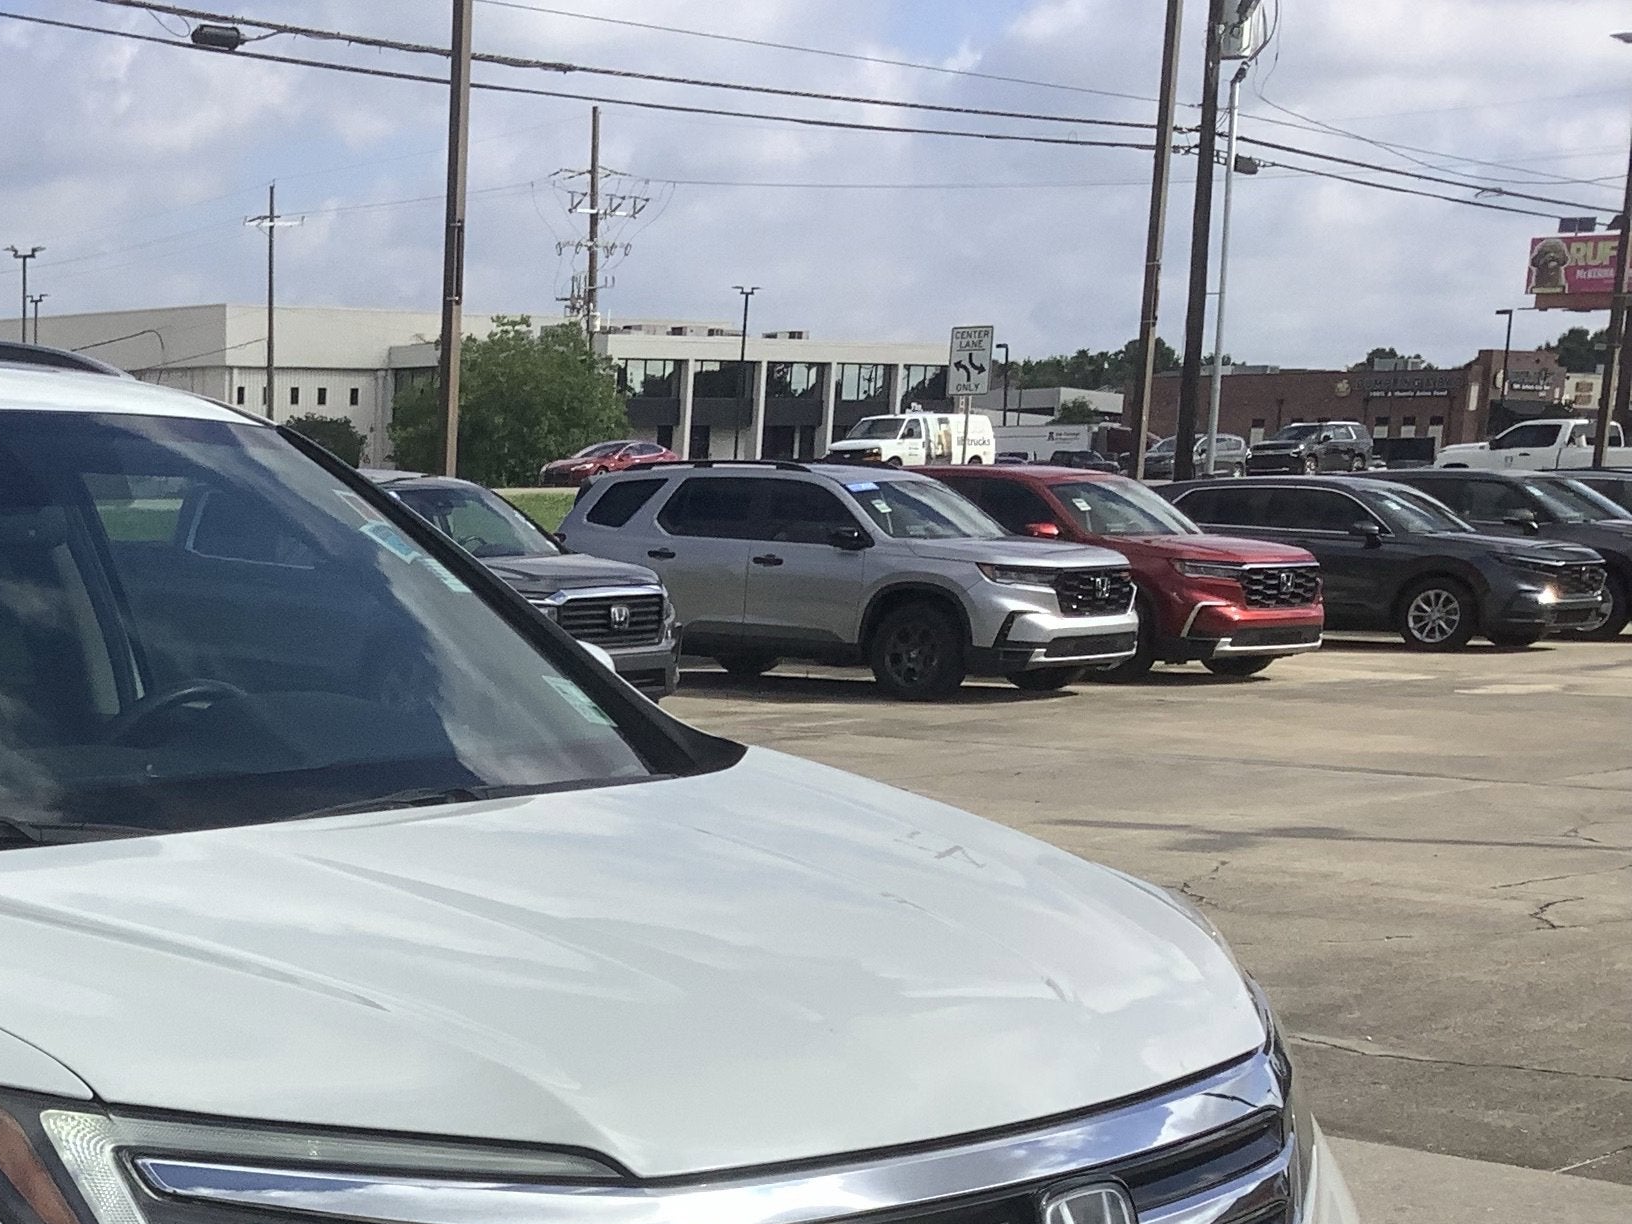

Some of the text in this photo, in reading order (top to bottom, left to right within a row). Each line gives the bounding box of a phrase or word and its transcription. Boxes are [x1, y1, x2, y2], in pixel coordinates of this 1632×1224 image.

[955, 330, 990, 340] CENTER
[959, 340, 983, 349] LANE
[956, 383, 980, 393] ONLY
